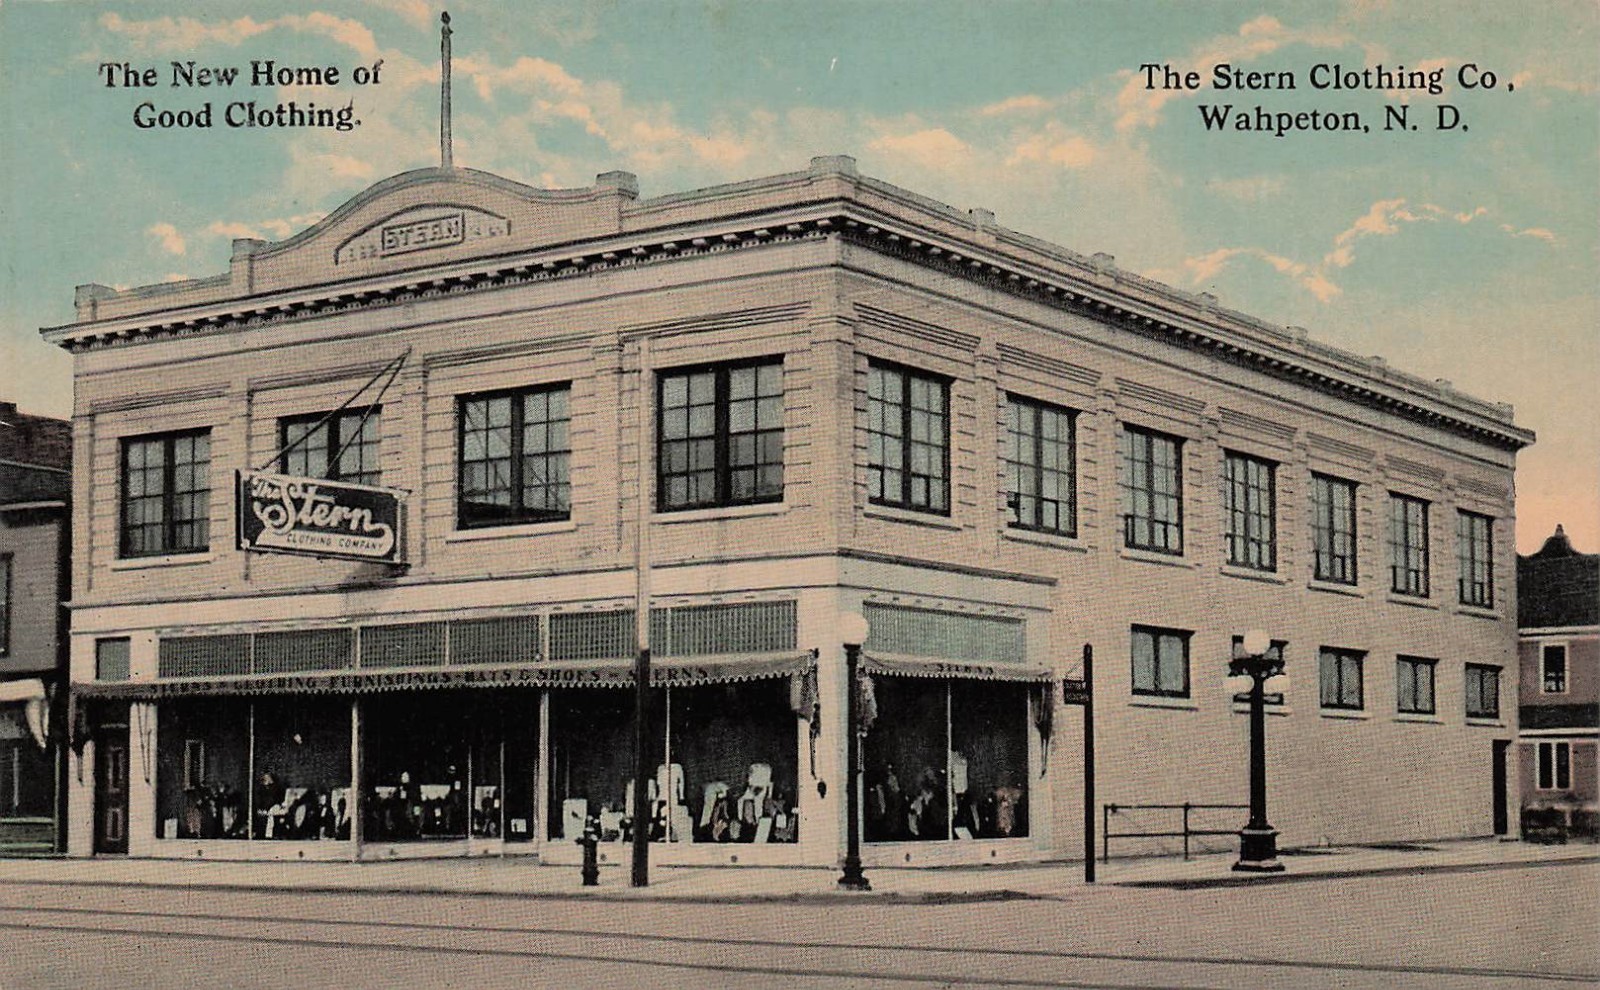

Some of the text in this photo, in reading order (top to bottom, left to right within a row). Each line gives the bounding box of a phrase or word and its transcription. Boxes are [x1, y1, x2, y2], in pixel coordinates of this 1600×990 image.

[384, 220, 460, 249] STERN
[286, 533, 384, 549] CLOTHING COMPANY
[464, 669, 513, 683] HATS
[535, 667, 602, 682] SHOES
